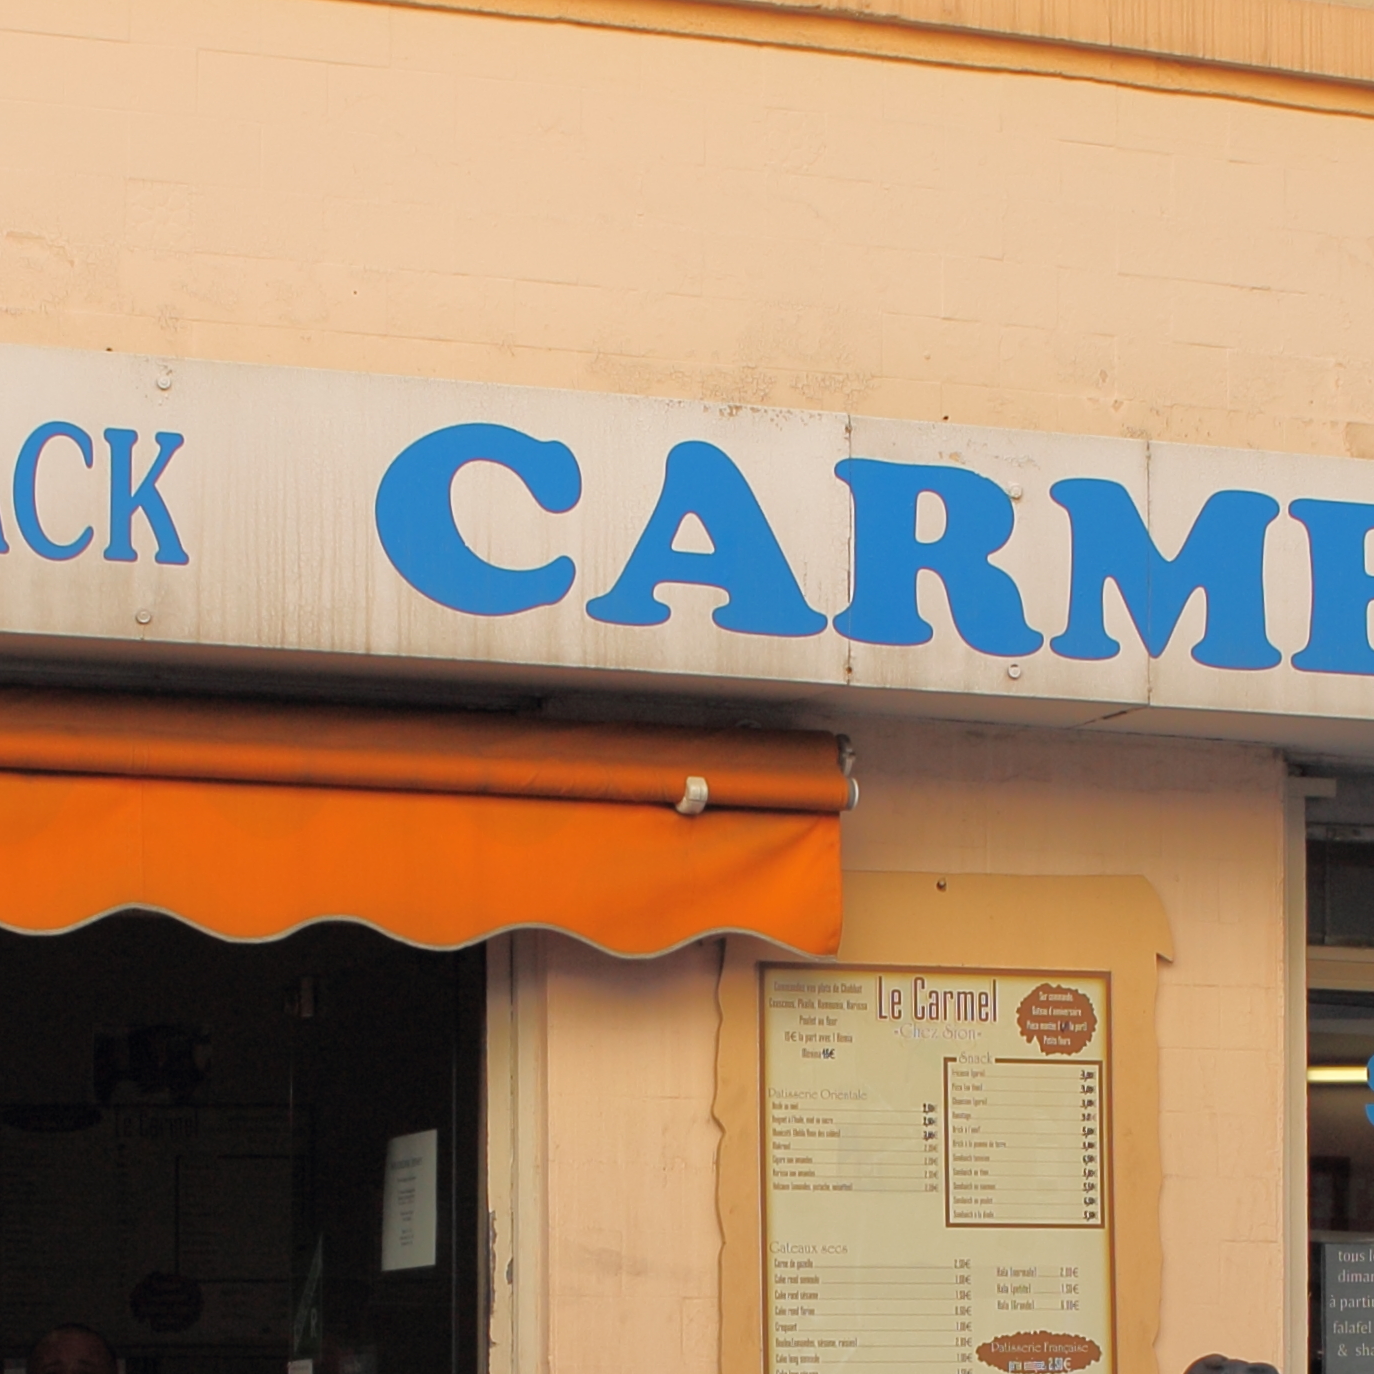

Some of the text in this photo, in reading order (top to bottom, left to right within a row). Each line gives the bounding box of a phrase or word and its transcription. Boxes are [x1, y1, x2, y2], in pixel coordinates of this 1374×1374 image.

[877, 975, 998, 1023] Le Carmel
[958, 1051, 994, 1065] Snack
[768, 1088, 868, 1101] Patisserie Orientale
[820, 1244, 848, 1254] secs
[1338, 1250, 1365, 1263] tous
[1329, 1295, 1336, 1308] à
[1332, 1321, 1373, 1334] falafel
[991, 1342, 1042, 1353] Patisserie
[1337, 1343, 1348, 1357] &
